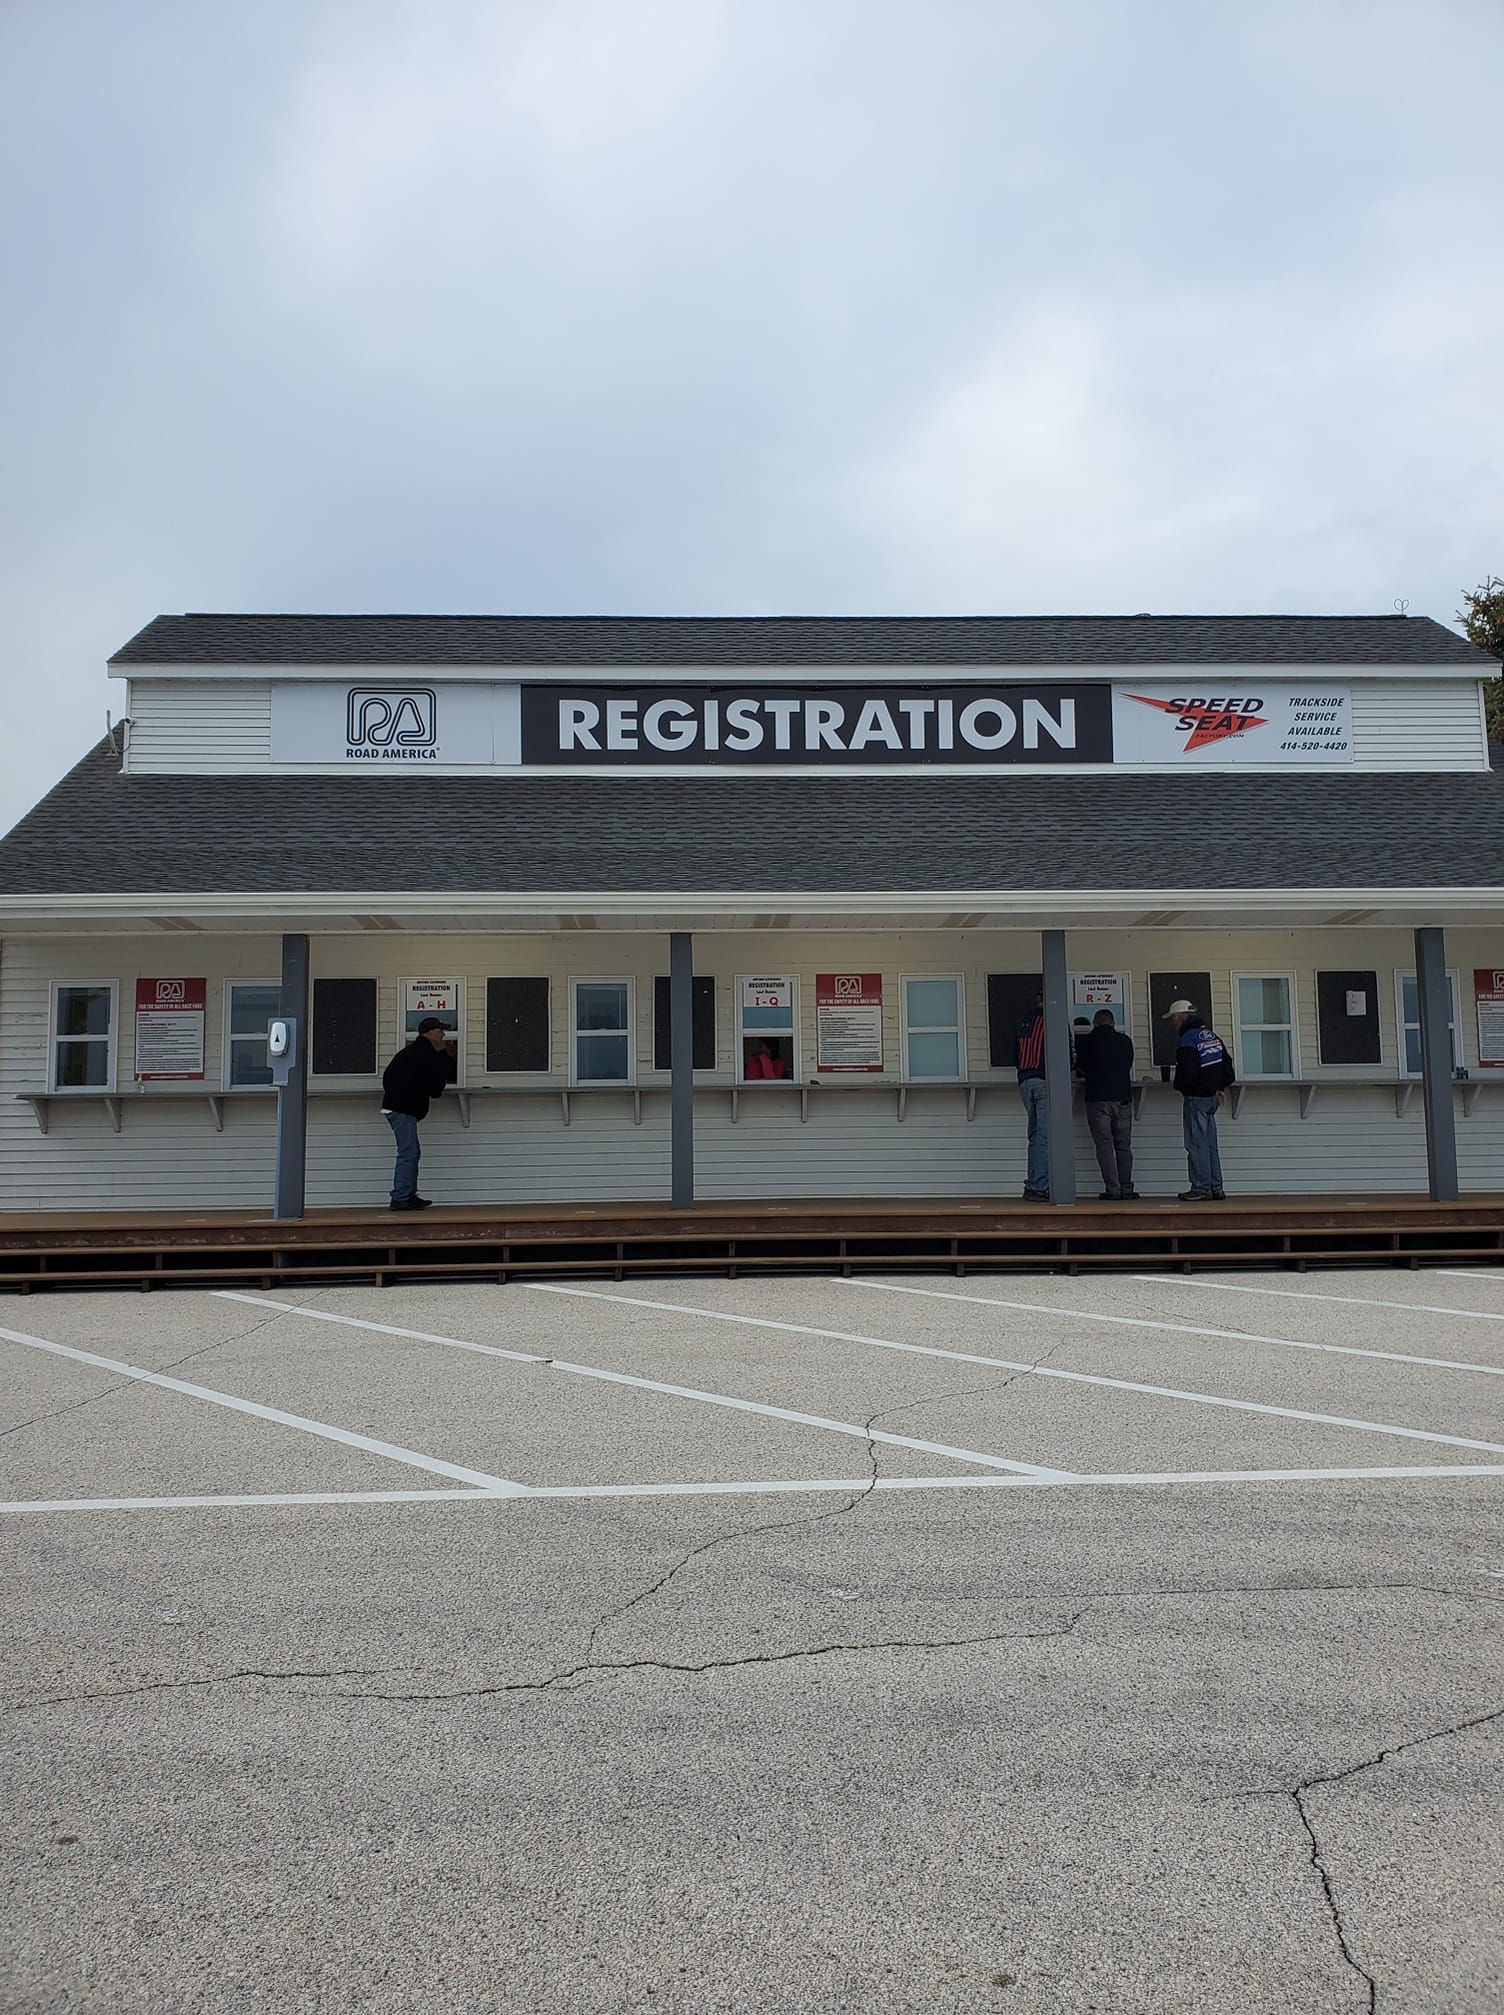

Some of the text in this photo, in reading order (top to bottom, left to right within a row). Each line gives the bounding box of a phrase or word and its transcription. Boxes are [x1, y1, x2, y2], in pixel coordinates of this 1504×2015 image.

[1164, 698, 1264, 713] SPEED
[1288, 698, 1344, 707] TRACKSIDE
[1294, 712, 1338, 721] SERVICE
[558, 698, 1076, 751] REGISTRATION
[1174, 715, 1255, 731] SEAT
[1287, 727, 1343, 736] AVAILABLE
[1280, 742, 1348, 751] 414-520-4420
[346, 748, 436, 759] ROAD AMERICA
[754, 997, 760, 1006] I
[769, 997, 779, 1006] Q
[1086, 994, 1094, 1003] R
[1104, 994, 1112, 1003] Z
[417, 1000, 425, 1009] A
[437, 1000, 446, 1009] H
